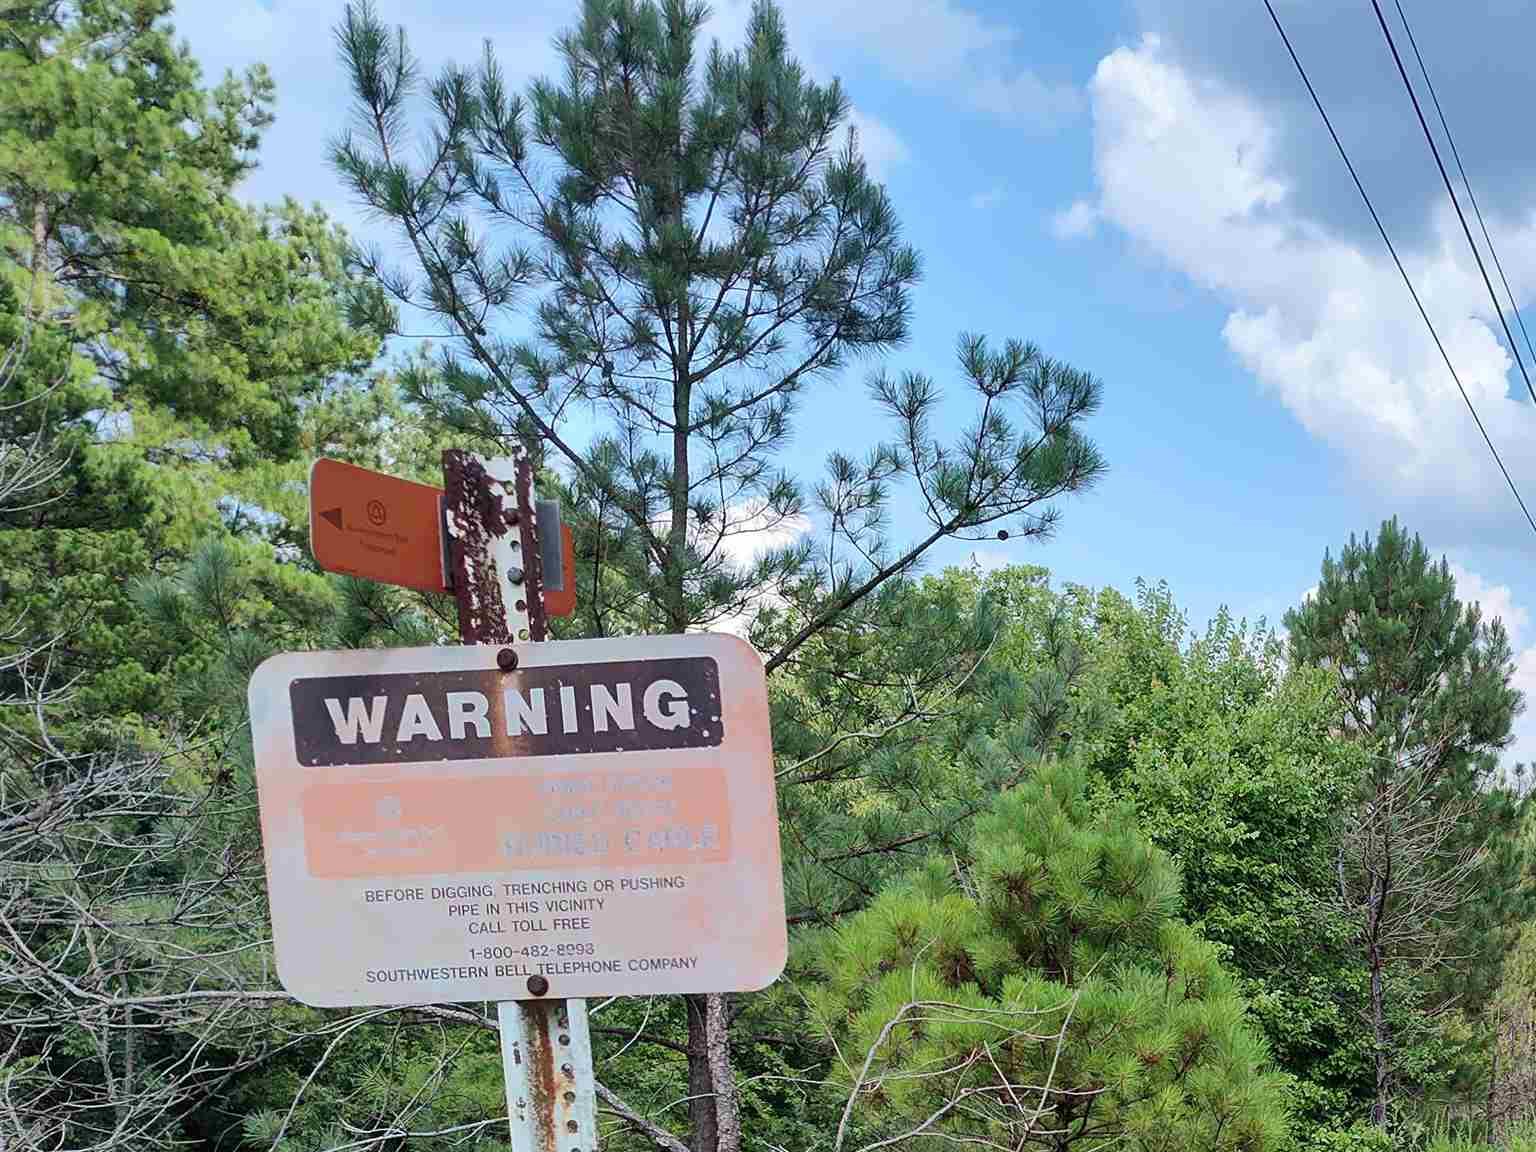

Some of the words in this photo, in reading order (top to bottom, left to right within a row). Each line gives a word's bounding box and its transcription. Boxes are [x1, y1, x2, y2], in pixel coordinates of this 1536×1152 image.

[325, 679, 692, 745] WARNING
[365, 889, 424, 903] BEFORE
[503, 881, 587, 896] TRENCHING
[593, 879, 615, 892] OR
[620, 876, 686, 890] PUSHING
[449, 904, 480, 917] PIPE
[486, 903, 500, 915] IN
[506, 901, 539, 914] THIS
[545, 898, 605, 913] VICINITY
[468, 921, 506, 935] CALL
[512, 919, 548, 932] TOLL
[553, 917, 591, 931] FREE
[366, 966, 489, 983] SOUTHWESTERN
[495, 964, 533, 977] BELL
[536, 960, 622, 975] TELEPHONE
[628, 957, 698, 972] COMPANY
